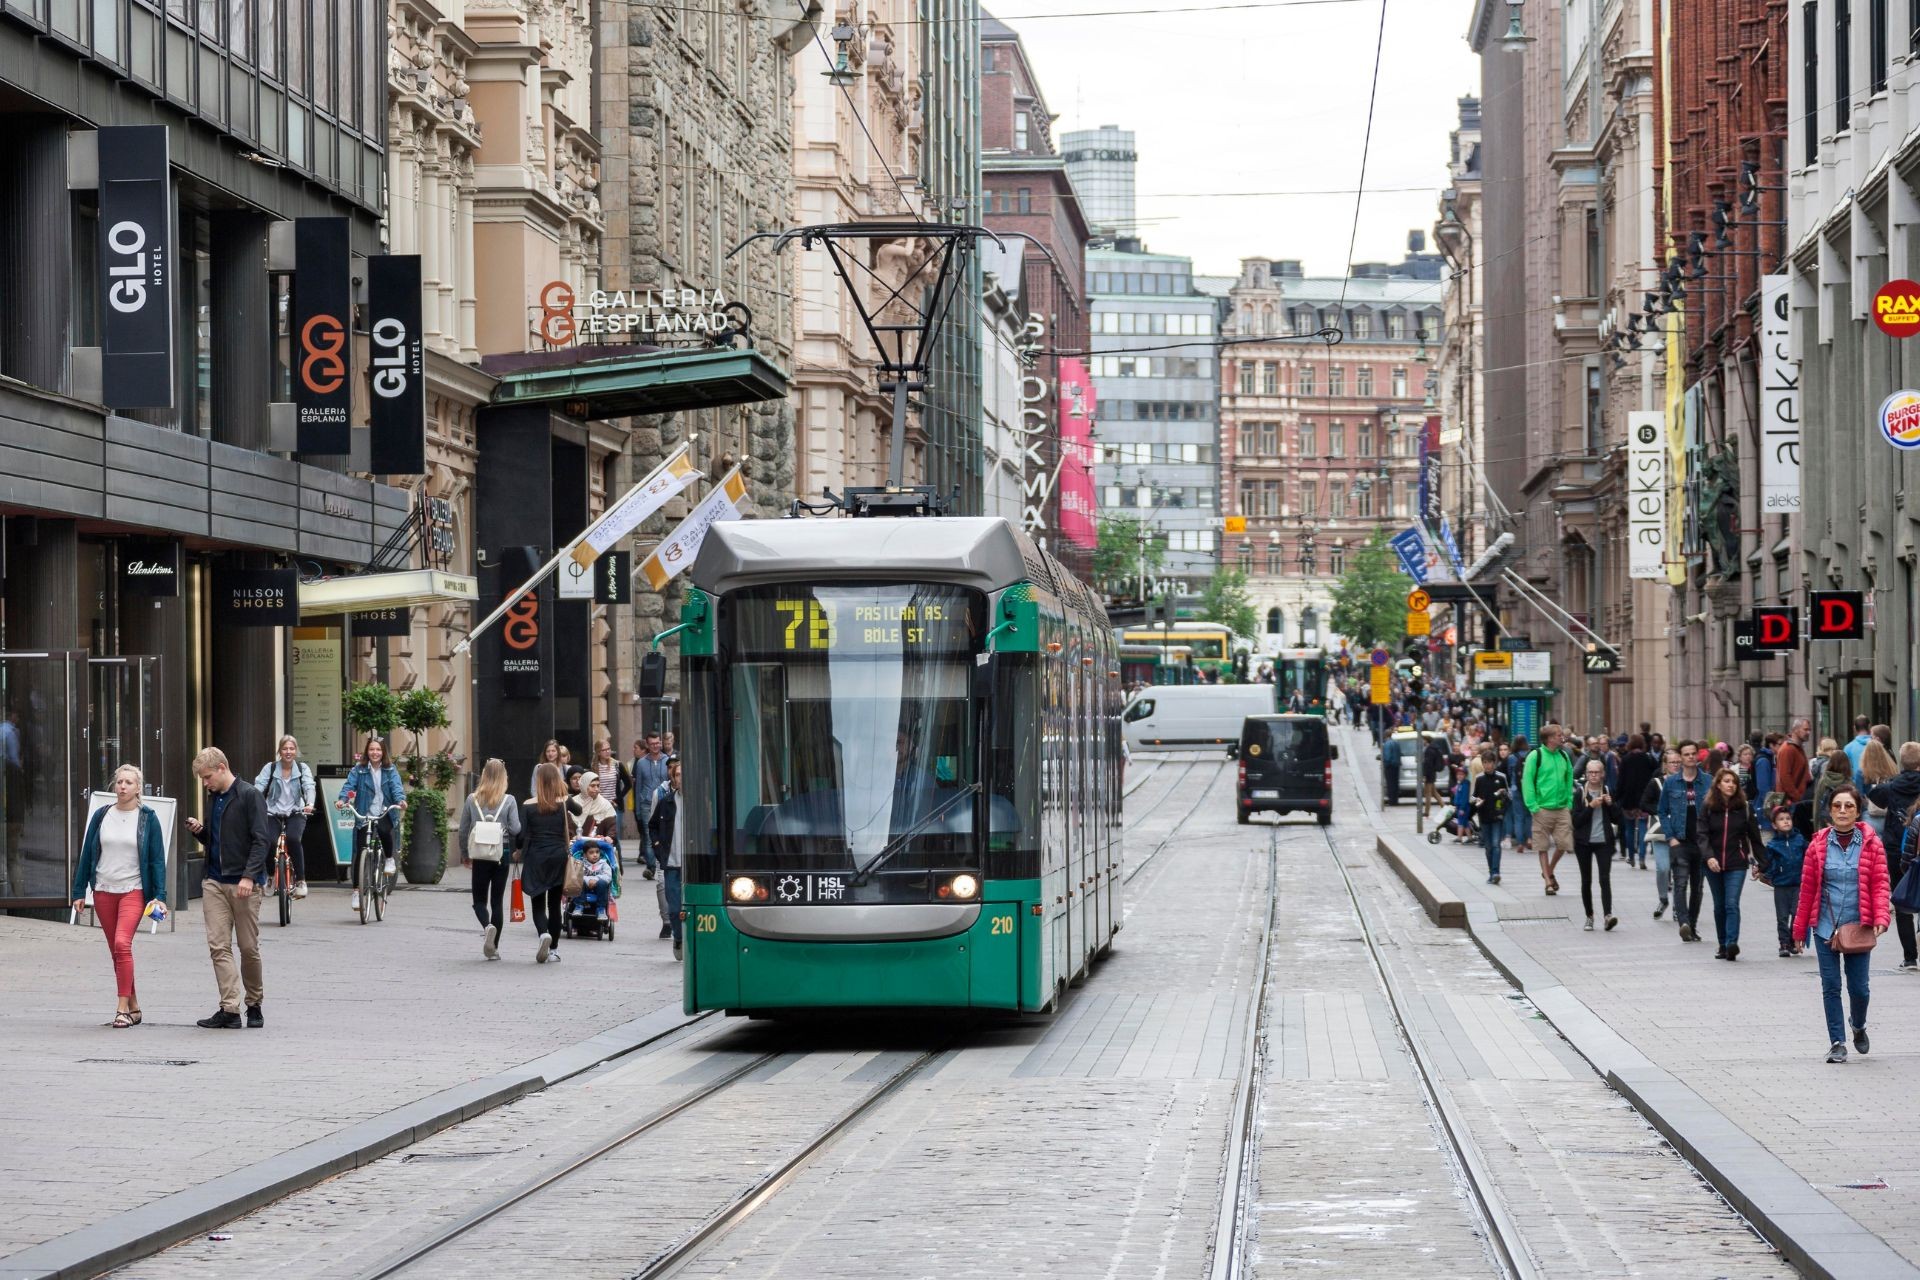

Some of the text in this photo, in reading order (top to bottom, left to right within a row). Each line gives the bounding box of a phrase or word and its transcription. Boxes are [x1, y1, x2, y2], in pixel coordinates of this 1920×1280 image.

[109, 221, 146, 313] GLO
[153, 245, 162, 285] HOTEL
[590, 288, 727, 308] GALLERIA
[590, 312, 728, 333] ESPLANAD
[373, 318, 406, 398] GLO
[412, 340, 420, 374] HOTEL
[301, 407, 345, 415] GALLERIA
[1427, 455, 1441, 491] Pizza
[1631, 450, 1661, 545] aleksi
[233, 588, 284, 598] NILSON
[1149, 577, 1188, 596] ktia
[233, 598, 284, 608] SHOES
[351, 611, 398, 620] SHOES
[855, 606, 949, 621] PASILAN AS.
[1820, 600, 1854, 631] D
[775, 600, 837, 649] 7B
[1760, 614, 1792, 643] D
[907, 628, 932, 643] ST.
[1586, 655, 1611, 669] Zio
[818, 877, 845, 888] HSL
[818, 888, 846, 899] HRT
[697, 914, 717, 933] 210
[991, 916, 1013, 935] 210
